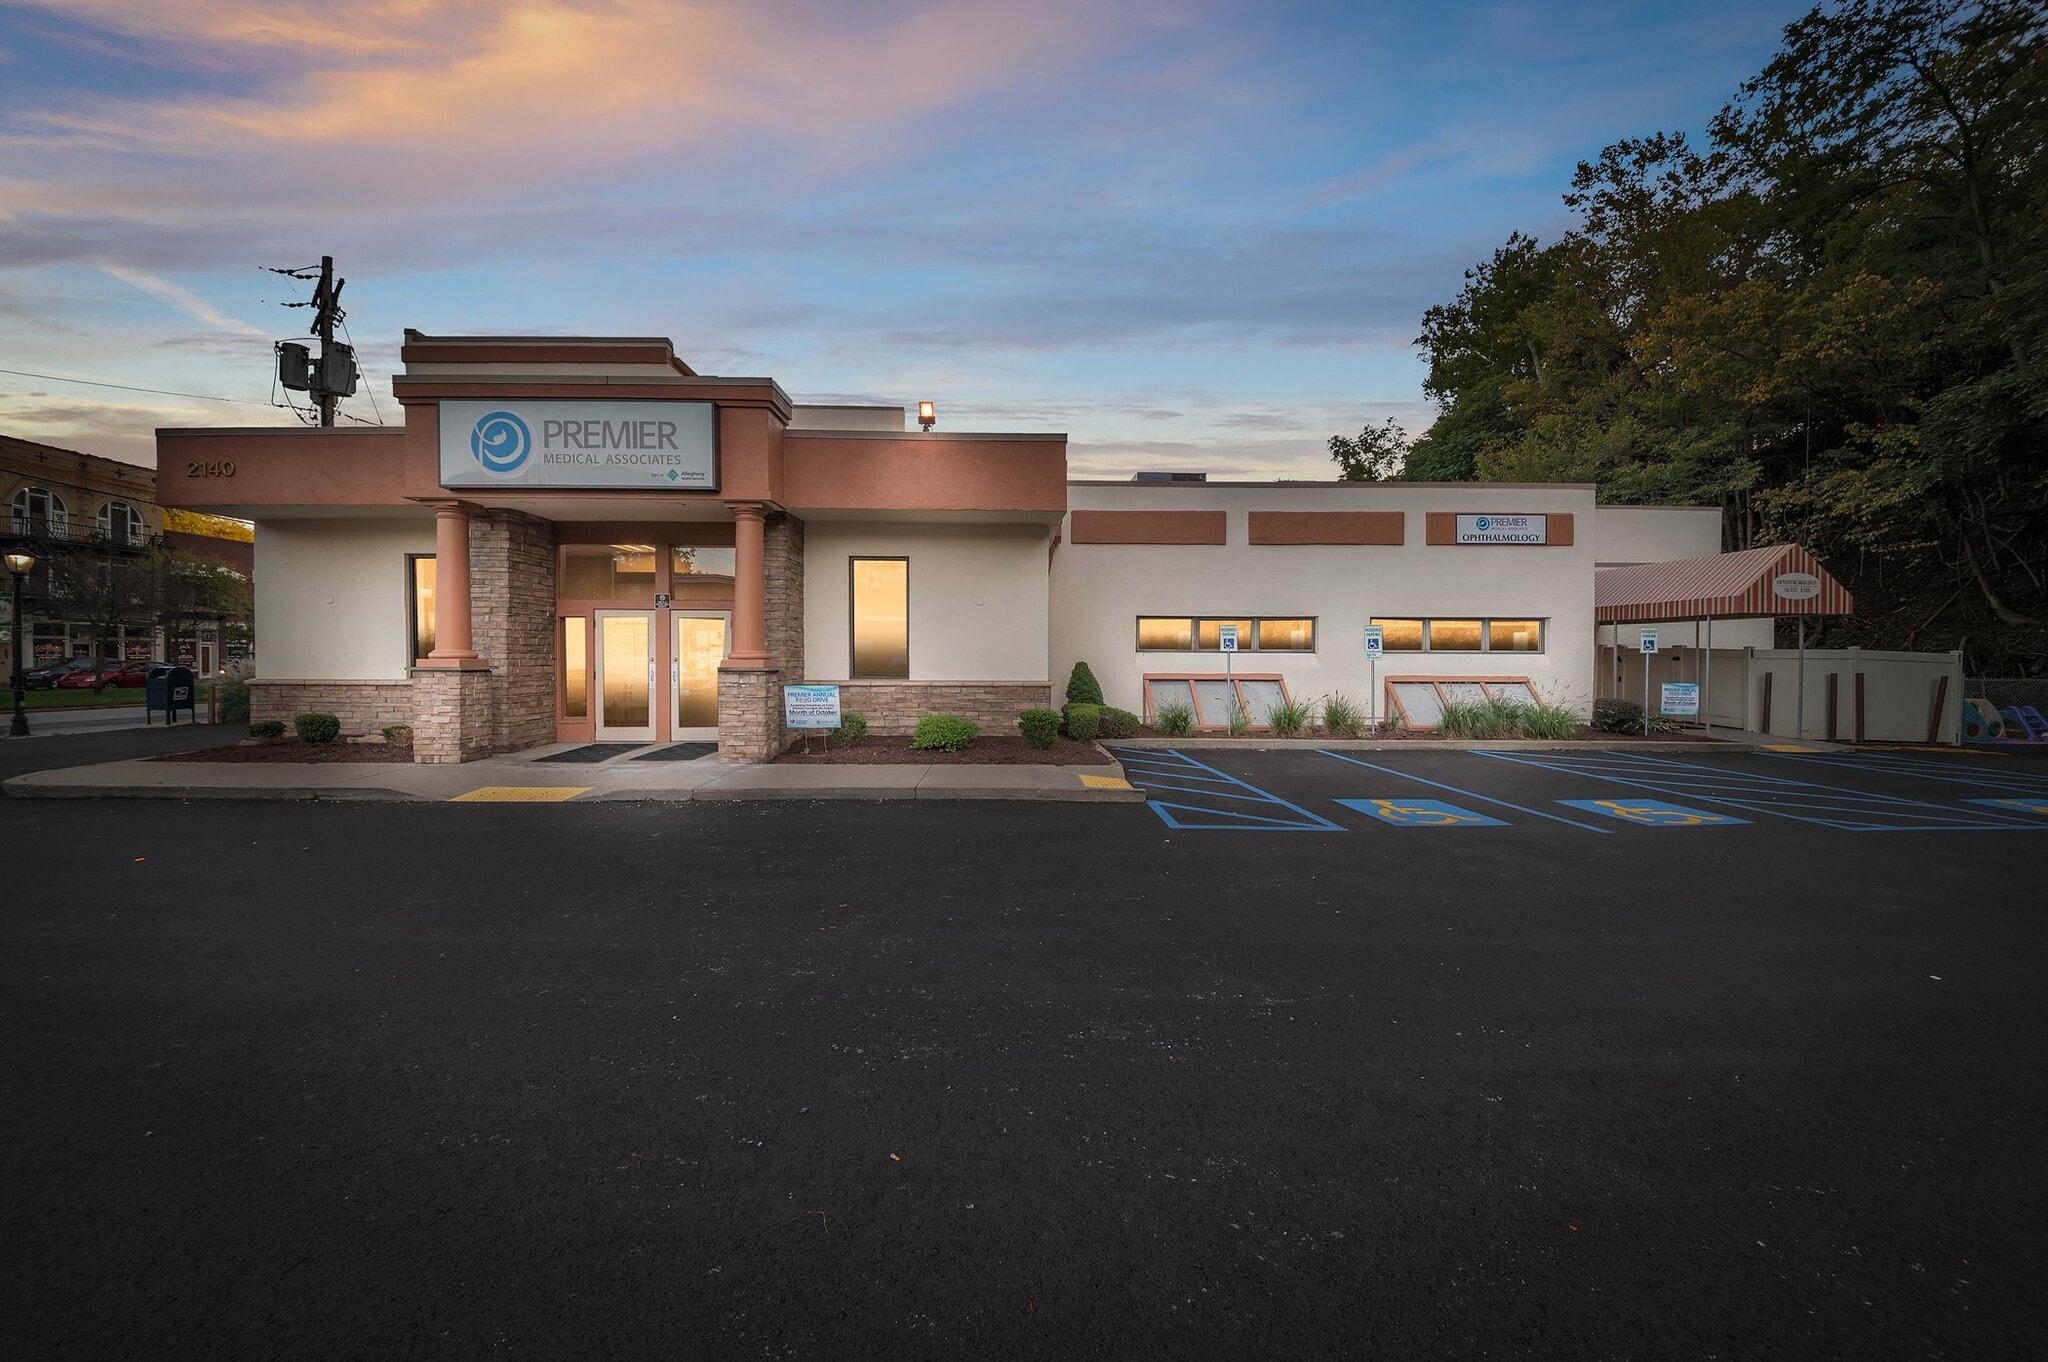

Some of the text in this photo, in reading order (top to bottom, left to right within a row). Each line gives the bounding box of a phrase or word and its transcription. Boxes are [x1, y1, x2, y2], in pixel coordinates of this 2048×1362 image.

[543, 420, 679, 450] PREMIER
[543, 453, 682, 465] MEDICAL ASSOCIATES
[187, 460, 236, 478] 2140
[1491, 517, 1528, 527] PREMIER
[1462, 533, 1541, 542] OPHTHALMOLOGY
